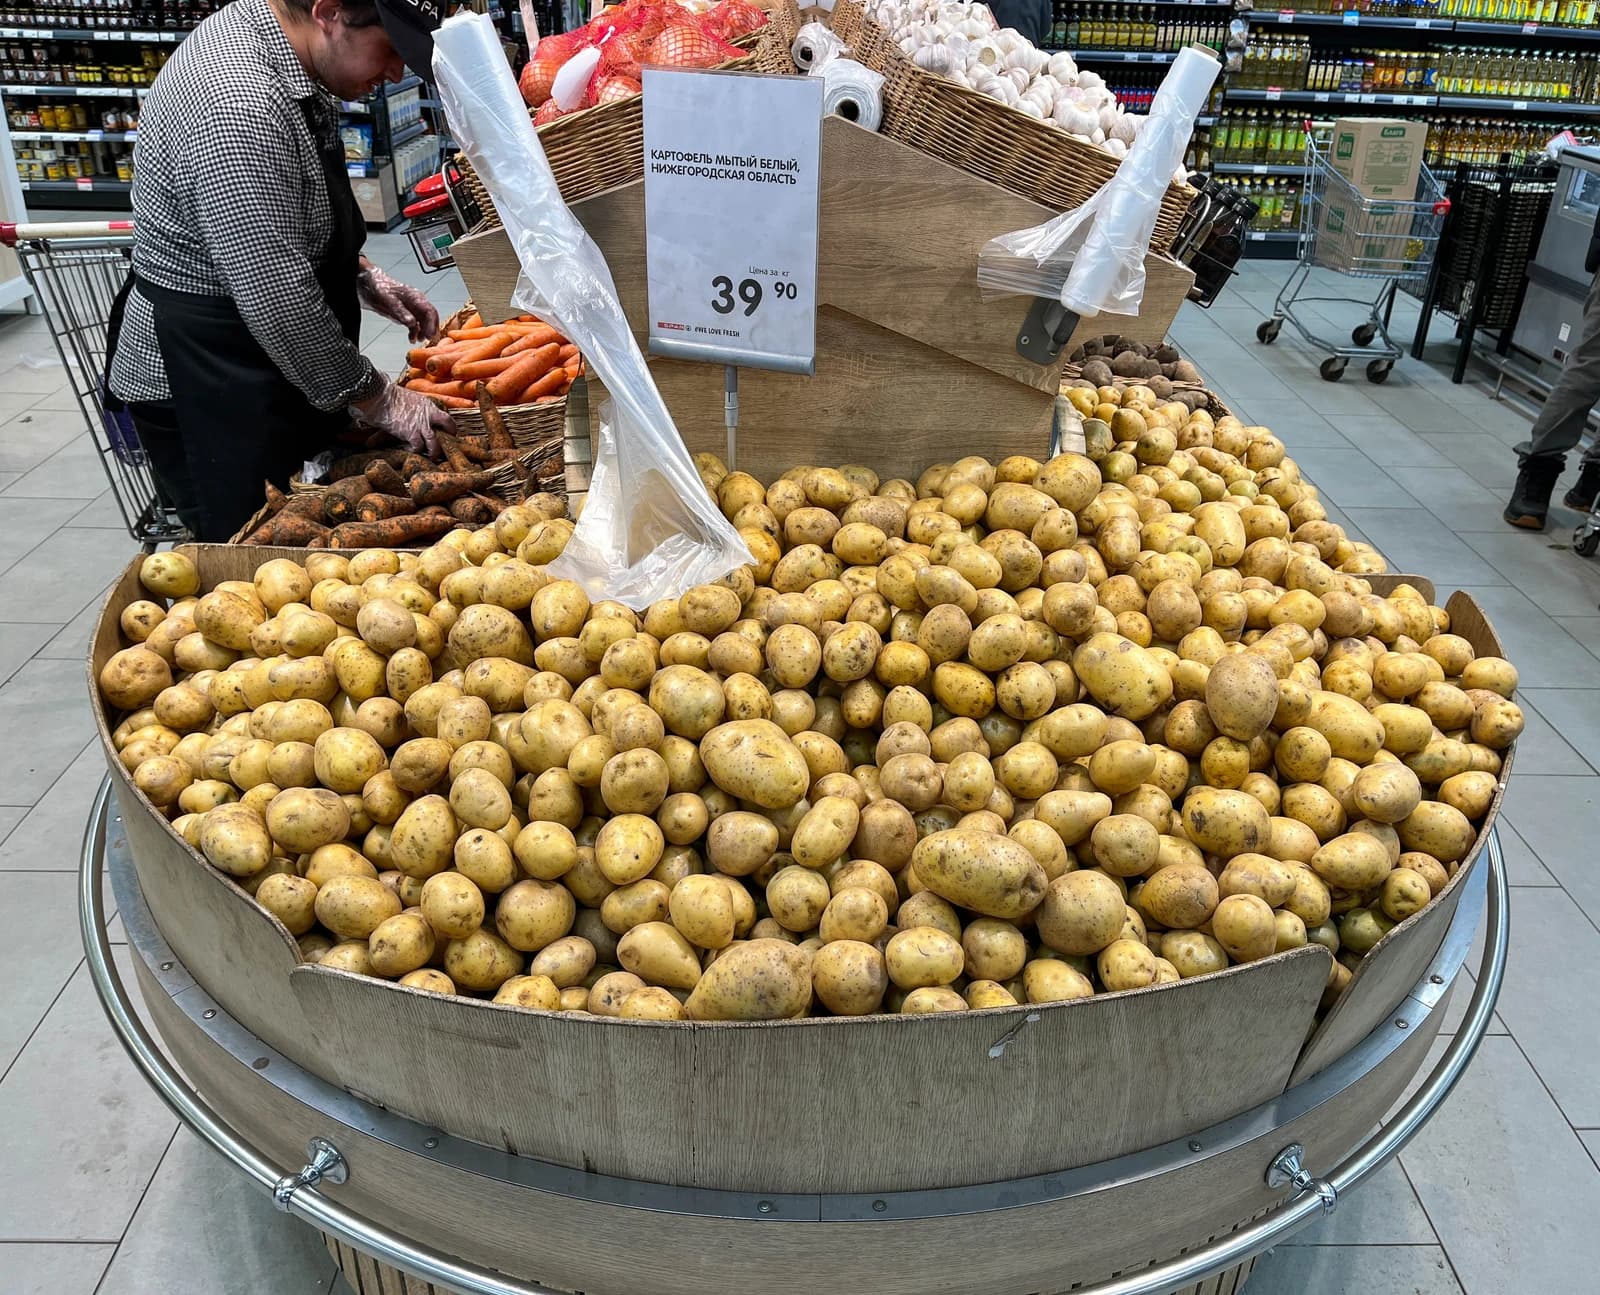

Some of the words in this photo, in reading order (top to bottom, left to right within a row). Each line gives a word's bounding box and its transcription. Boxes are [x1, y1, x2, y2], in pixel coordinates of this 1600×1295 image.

[650, 149, 713, 165] КАРТОФЕЛЬ
[715, 155, 758, 168] МЫТЫЙ
[760, 158, 800, 173] БЕЛЫЙ,
[651, 163, 745, 181] НИЖЕГОРОДСКАЯ
[747, 171, 797, 185] ОБЛАСТЬ
[749, 266, 768, 276] Цена
[711, 275, 763, 317] 39
[774, 281, 798, 300] 90
[708, 327, 722, 336] LOVE
[723, 328, 740, 337] FRESH
